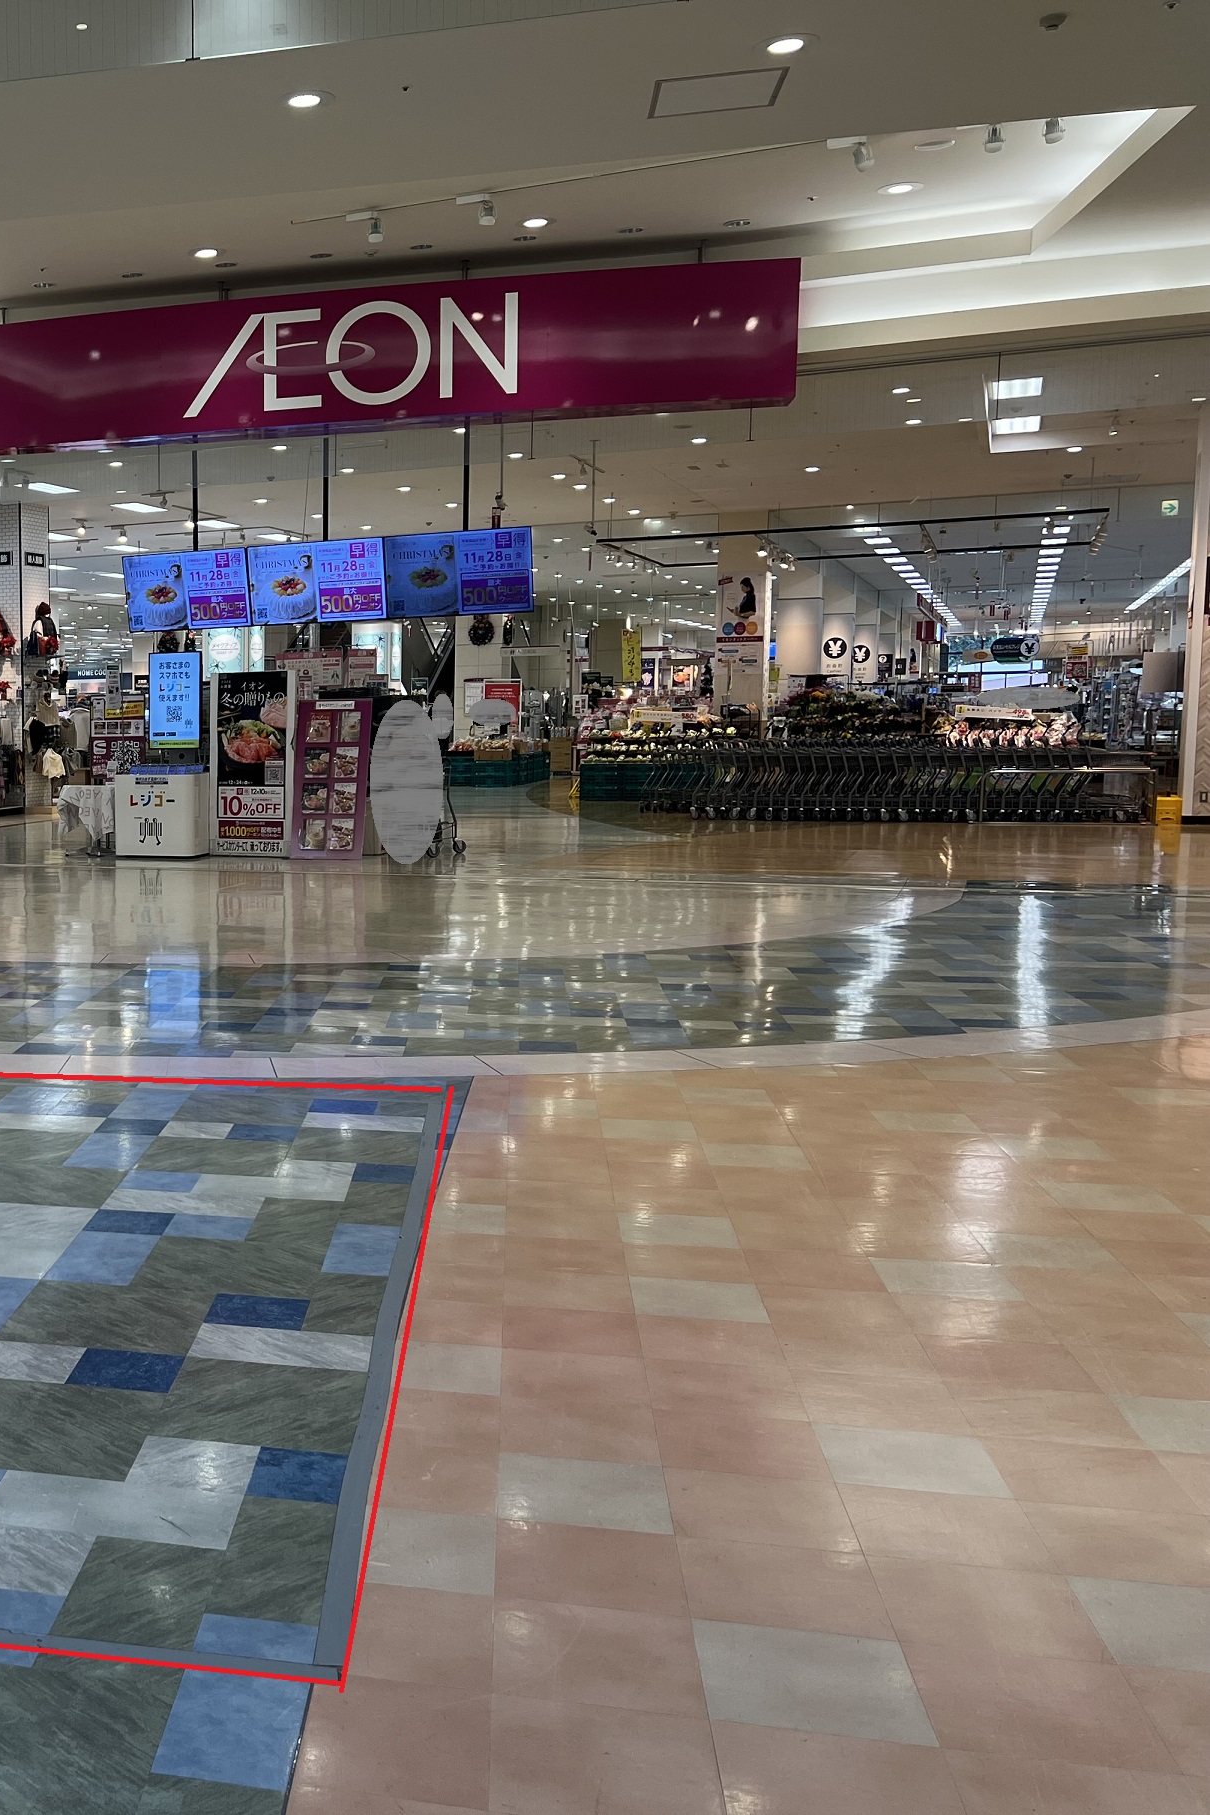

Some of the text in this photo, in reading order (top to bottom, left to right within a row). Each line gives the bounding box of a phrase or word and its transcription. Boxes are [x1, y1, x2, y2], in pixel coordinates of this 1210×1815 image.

[392, 549, 449, 560] CHRISTMAS
[464, 550, 512, 564] 11月28日
[255, 559, 308, 569] CHRISTMAS
[321, 560, 366, 573] 11月28日
[130, 569, 177, 579] CHRISTMAS
[190, 569, 230, 582] 11月28日
[158, 661, 191, 670] お客さまの
[77, 669, 93, 677] HOME
[159, 671, 191, 680] スマホでも
[159, 683, 191, 692] レジゴー
[241, 681, 265, 691] イオン
[221, 691, 286, 709] 冬の贈りもの
[130, 791, 175, 807] レジゴー
[221, 796, 282, 816] 10%OFF
